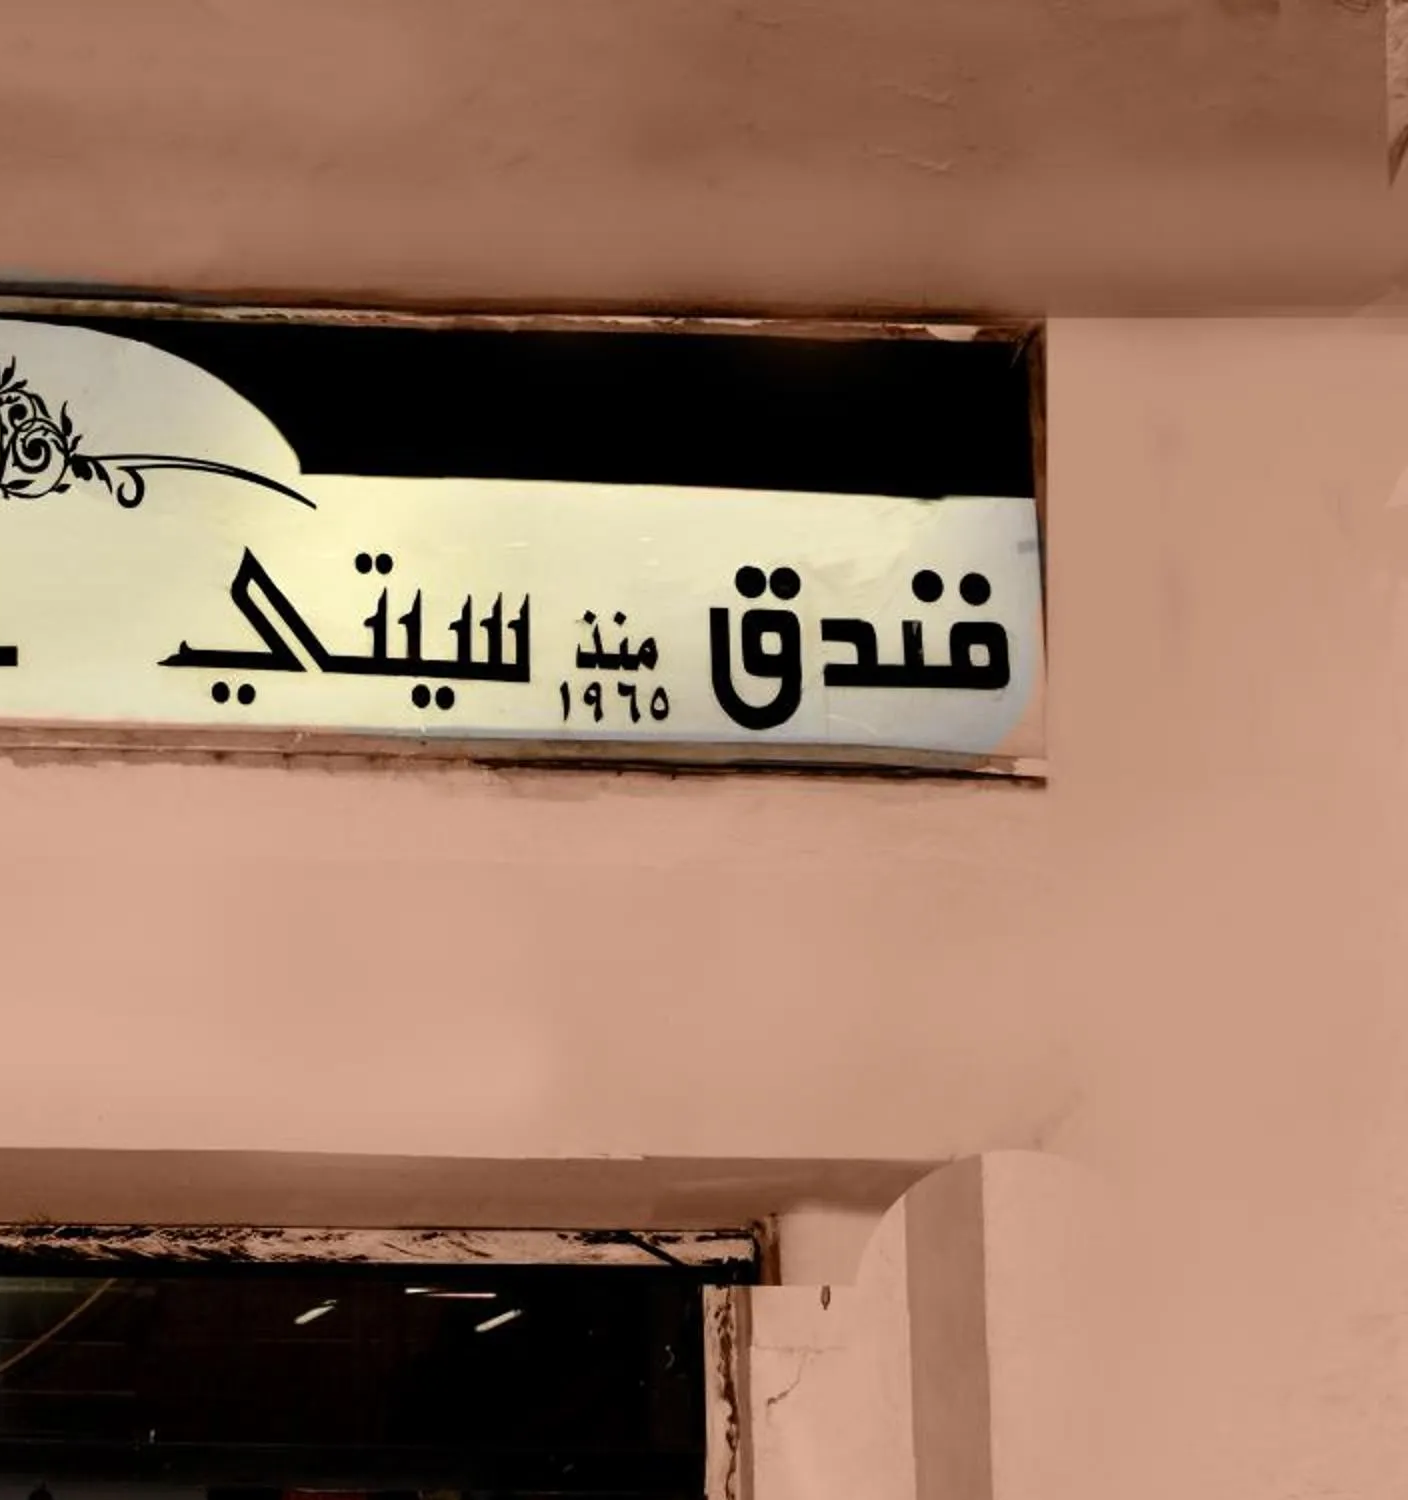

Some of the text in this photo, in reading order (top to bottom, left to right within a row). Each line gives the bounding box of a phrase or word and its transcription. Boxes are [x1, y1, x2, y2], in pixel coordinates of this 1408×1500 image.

[158, 547, 1011, 731] فندق منذ سيتي
[559, 681, 670, 724] ١٩٦٥
